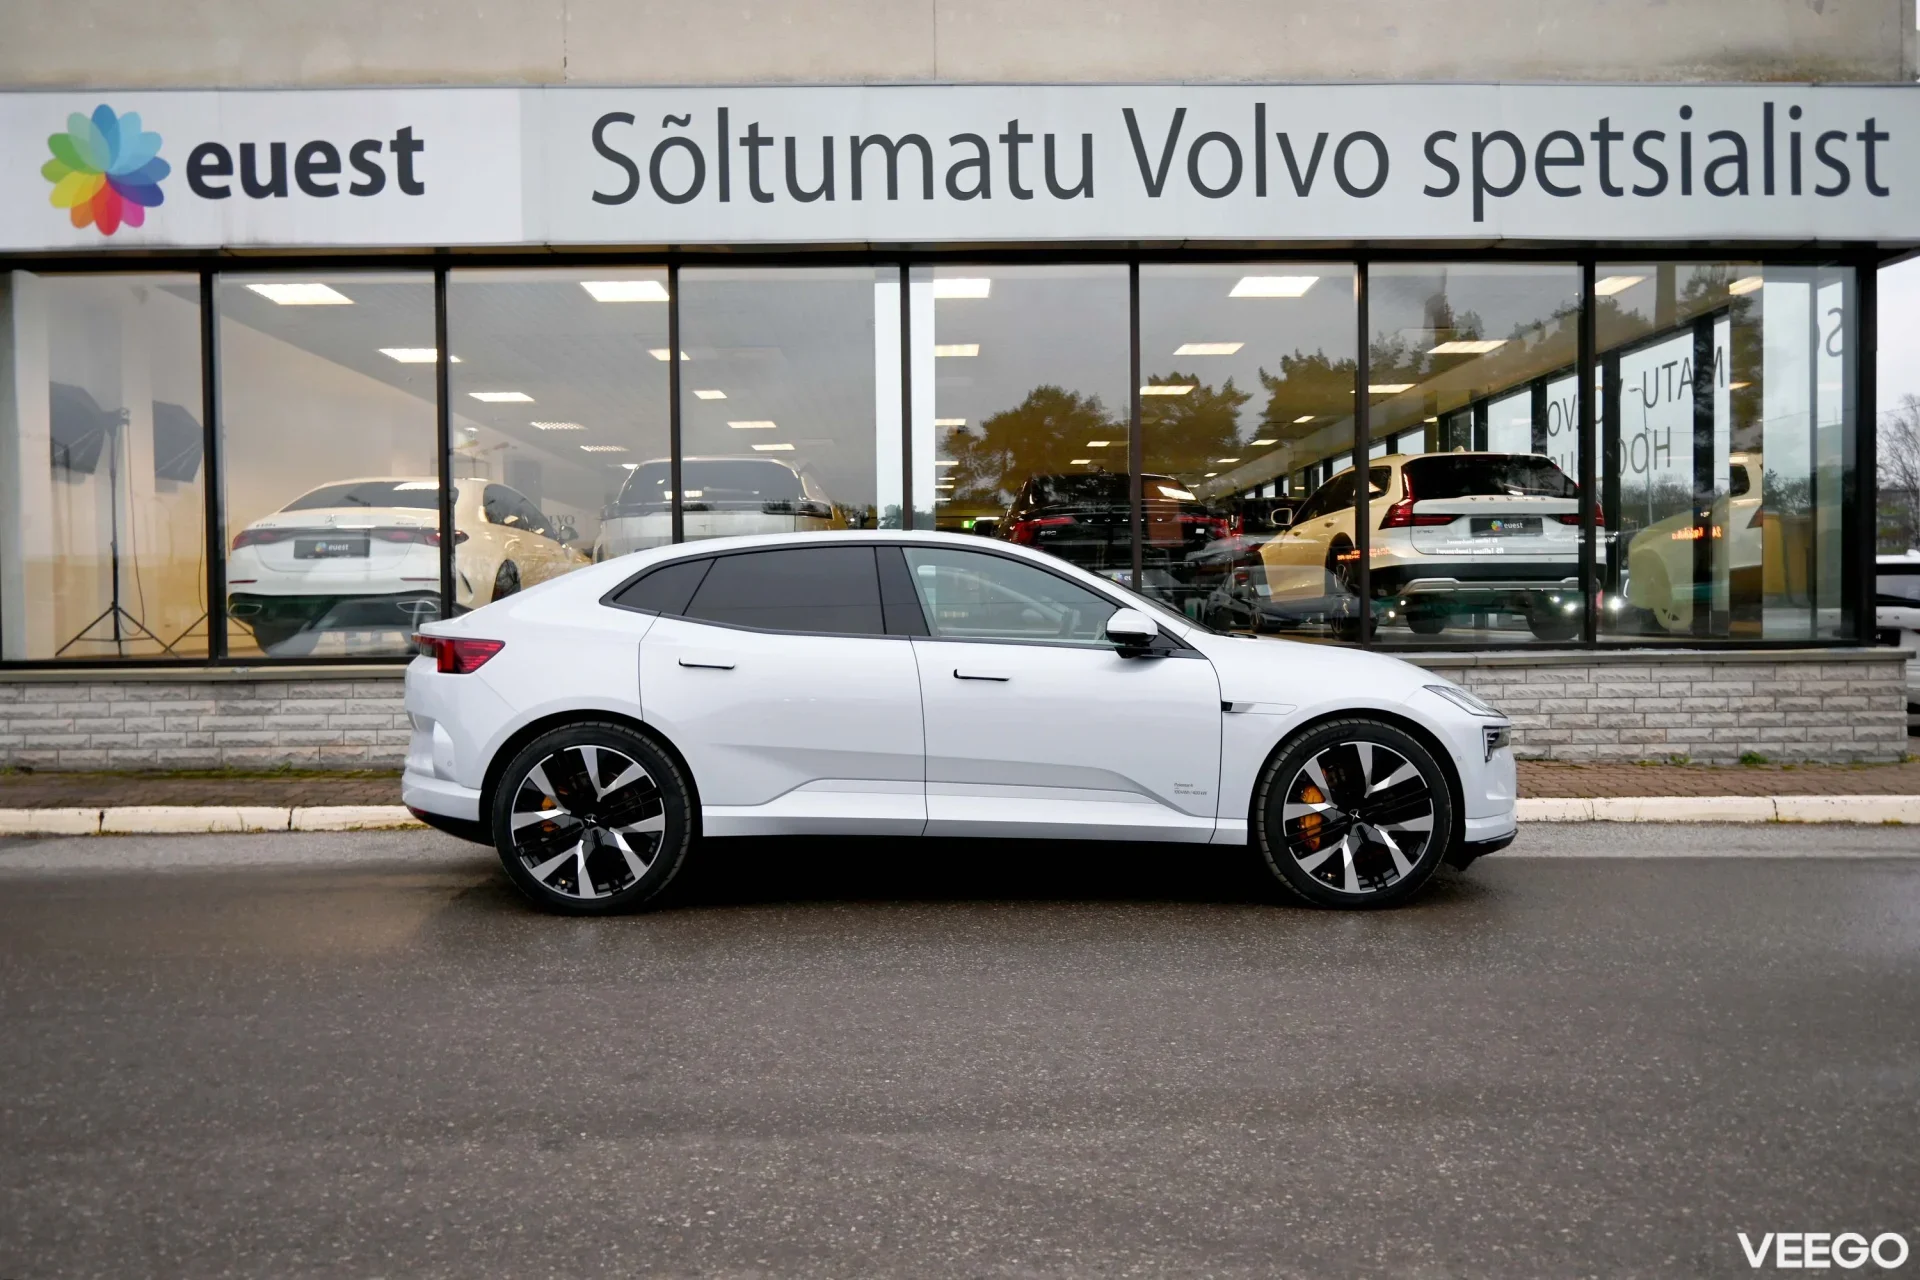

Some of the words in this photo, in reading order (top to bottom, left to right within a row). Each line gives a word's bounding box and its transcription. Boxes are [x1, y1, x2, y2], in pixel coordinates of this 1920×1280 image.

[186, 126, 425, 200] euest
[591, 106, 1094, 206] Sõltumatu
[1122, 102, 1389, 199] Volvo
[1423, 101, 1890, 223] spetsialist
[1503, 521, 1524, 529] euest
[328, 543, 349, 551] euest
